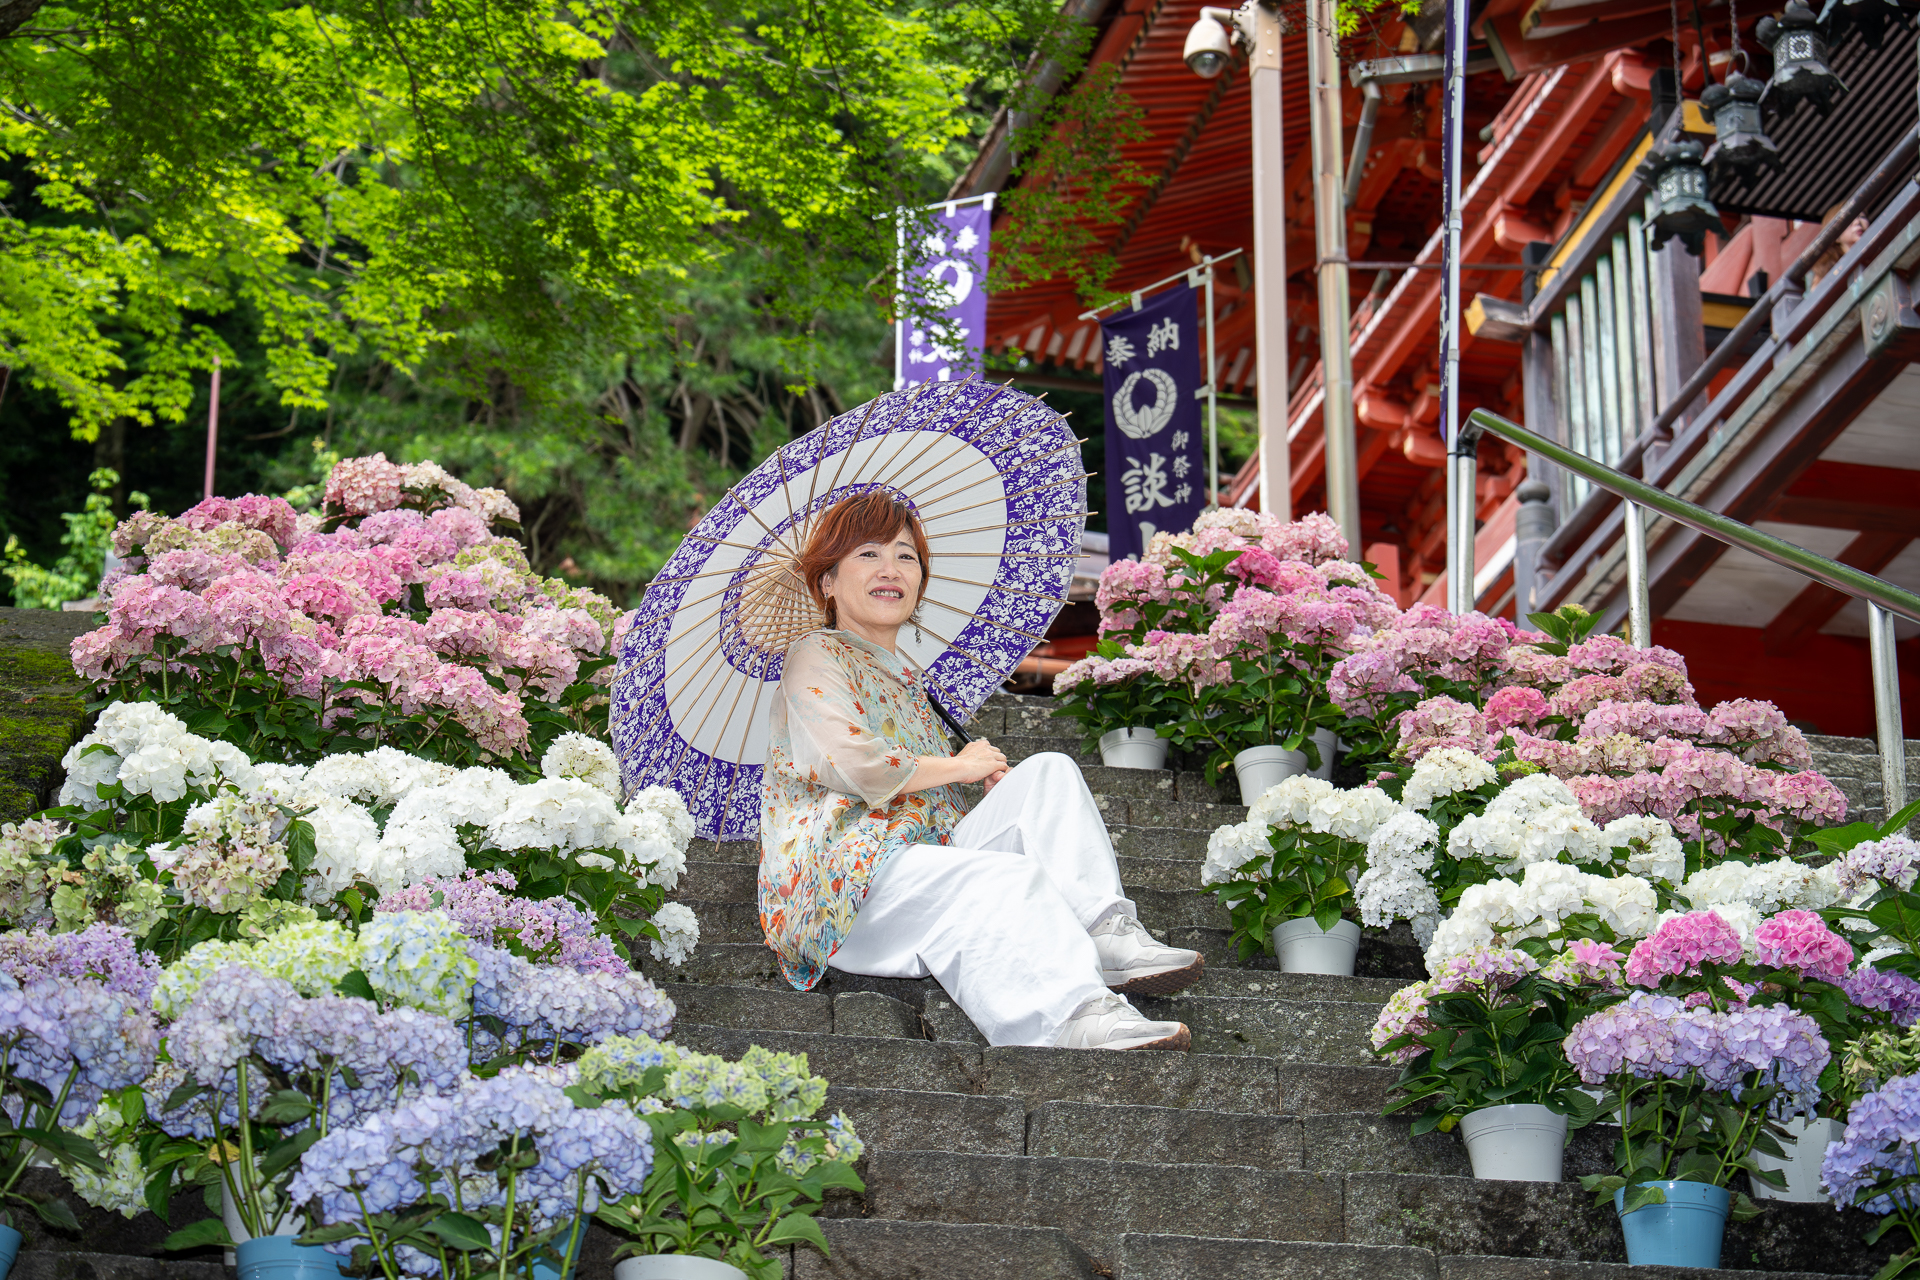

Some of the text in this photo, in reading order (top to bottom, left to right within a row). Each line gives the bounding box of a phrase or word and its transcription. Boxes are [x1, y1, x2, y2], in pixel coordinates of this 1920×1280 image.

[1105, 317, 1180, 369] 奉納
[1171, 429, 1193, 504] 御祭神
